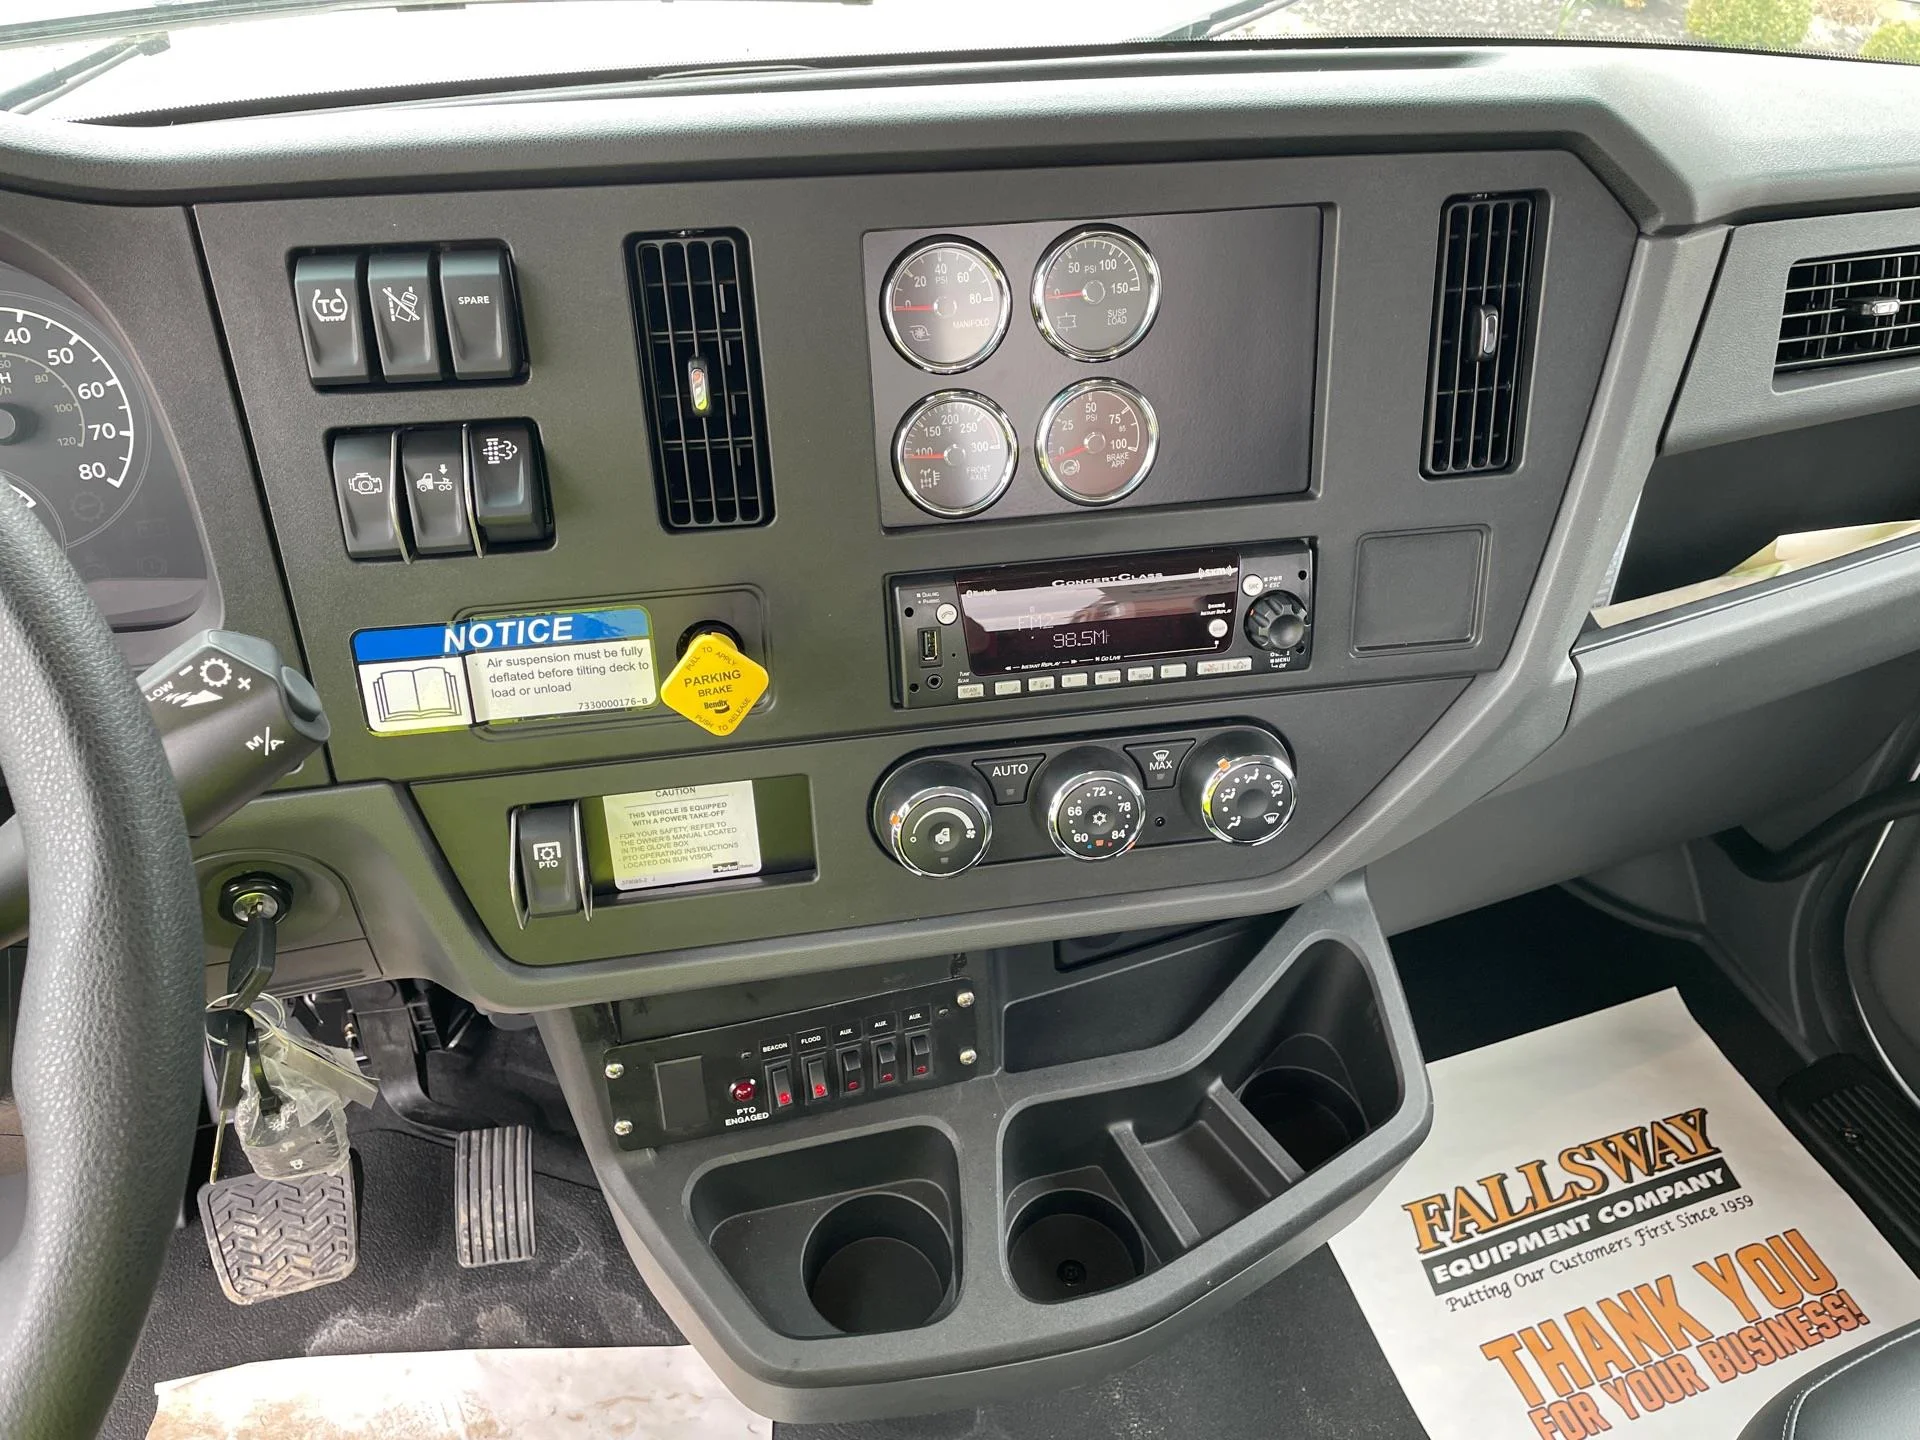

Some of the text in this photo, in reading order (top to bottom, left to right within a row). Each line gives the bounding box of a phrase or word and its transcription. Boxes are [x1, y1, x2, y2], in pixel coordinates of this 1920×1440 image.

[934, 263, 947, 274] 40
[1069, 258, 1117, 273] 50 PSI 100
[914, 275, 927, 288] 20
[935, 276, 948, 284] PSI
[956, 271, 969, 283] 60
[1111, 282, 1129, 294] 150
[458, 295, 490, 305] SPARE
[969, 293, 981, 304] 80
[317, 299, 342, 314] TC
[1107, 308, 1128, 318] SUSP
[952, 318, 990, 329] MANIFOLD
[1107, 316, 1128, 326] LOAD
[4, 327, 32, 345] 40
[47, 347, 74, 366] 50
[34, 374, 49, 384] 80
[77, 381, 105, 400] 60
[54, 403, 73, 413] 100
[1085, 402, 1097, 413] 50
[941, 414, 959, 426] 200
[1085, 414, 1098, 422] PSI
[1109, 414, 1122, 425] 75
[87, 422, 116, 441] 70
[924, 425, 941, 438] 150
[960, 422, 978, 434] 250
[1062, 420, 1074, 431] 25
[57, 436, 76, 447] 120
[970, 440, 989, 453] 300
[1110, 438, 1128, 450] 100
[1106, 451, 1130, 462] BRAKE
[78, 461, 106, 481] 80
[444, 617, 573, 653] NOTICE
[486, 646, 644, 668] Air suspension must be fully
[685, 655, 701, 671] PULL
[715, 651, 738, 666] APPLY
[489, 661, 649, 683] deflated before tilting deck to
[684, 669, 741, 688] PARKING
[144, 680, 175, 702] LOW
[491, 681, 572, 698] load or unload
[697, 684, 733, 698] BRAKE
[695, 714, 715, 728] PUSH
[728, 697, 752, 724] RELEASE
[992, 763, 1029, 777] AUTO
[1149, 760, 1173, 771] MAX
[655, 787, 696, 798] CAUTION
[1092, 786, 1107, 797] 72
[629, 811, 646, 820] THIS
[646, 807, 679, 817] VEHICLE
[690, 801, 727, 812] EQUIPPED
[1067, 806, 1082, 817] 66
[1117, 801, 1132, 813] 78
[632, 819, 652, 827] WITH
[660, 814, 688, 824] POWER
[689, 809, 726, 820] TAKE-OFF
[636, 829, 658, 838] YOUR
[690, 822, 715, 831] REFER
[636, 835, 671, 845] OWNER'S
[672, 831, 703, 840] MANUAL
[703, 827, 737, 837] LOCATED
[1111, 829, 1126, 840] 84
[1073, 832, 1089, 843] 60
[630, 845, 646, 853] THE
[646, 842, 672, 851] GLOVE
[673, 840, 689, 848] BOX
[639, 848, 683, 859] OPERATING
[684, 841, 739, 854] INSTRUCTIONS
[538, 860, 559, 869] PTO
[623, 860, 658, 869] LOCATED
[671, 855, 688, 863] SUN
[689, 852, 713, 860] VISOR
[801, 1035, 821, 1044] FLOOD
[762, 1042, 788, 1053] BEACON
[736, 1106, 756, 1116] PTO
[725, 1111, 770, 1127] ENGAGED
[1401, 1107, 1722, 1255] FALLSWAY
[1434, 1167, 1727, 1285] EQUIPMENT COMPANY
[1445, 1194, 1754, 1312] Putting Our Customers First Since 1959
[1479, 1228, 1839, 1408] THANK YOU
[1527, 1288, 1870, 1440] FOR YOUR BUSINESS!
